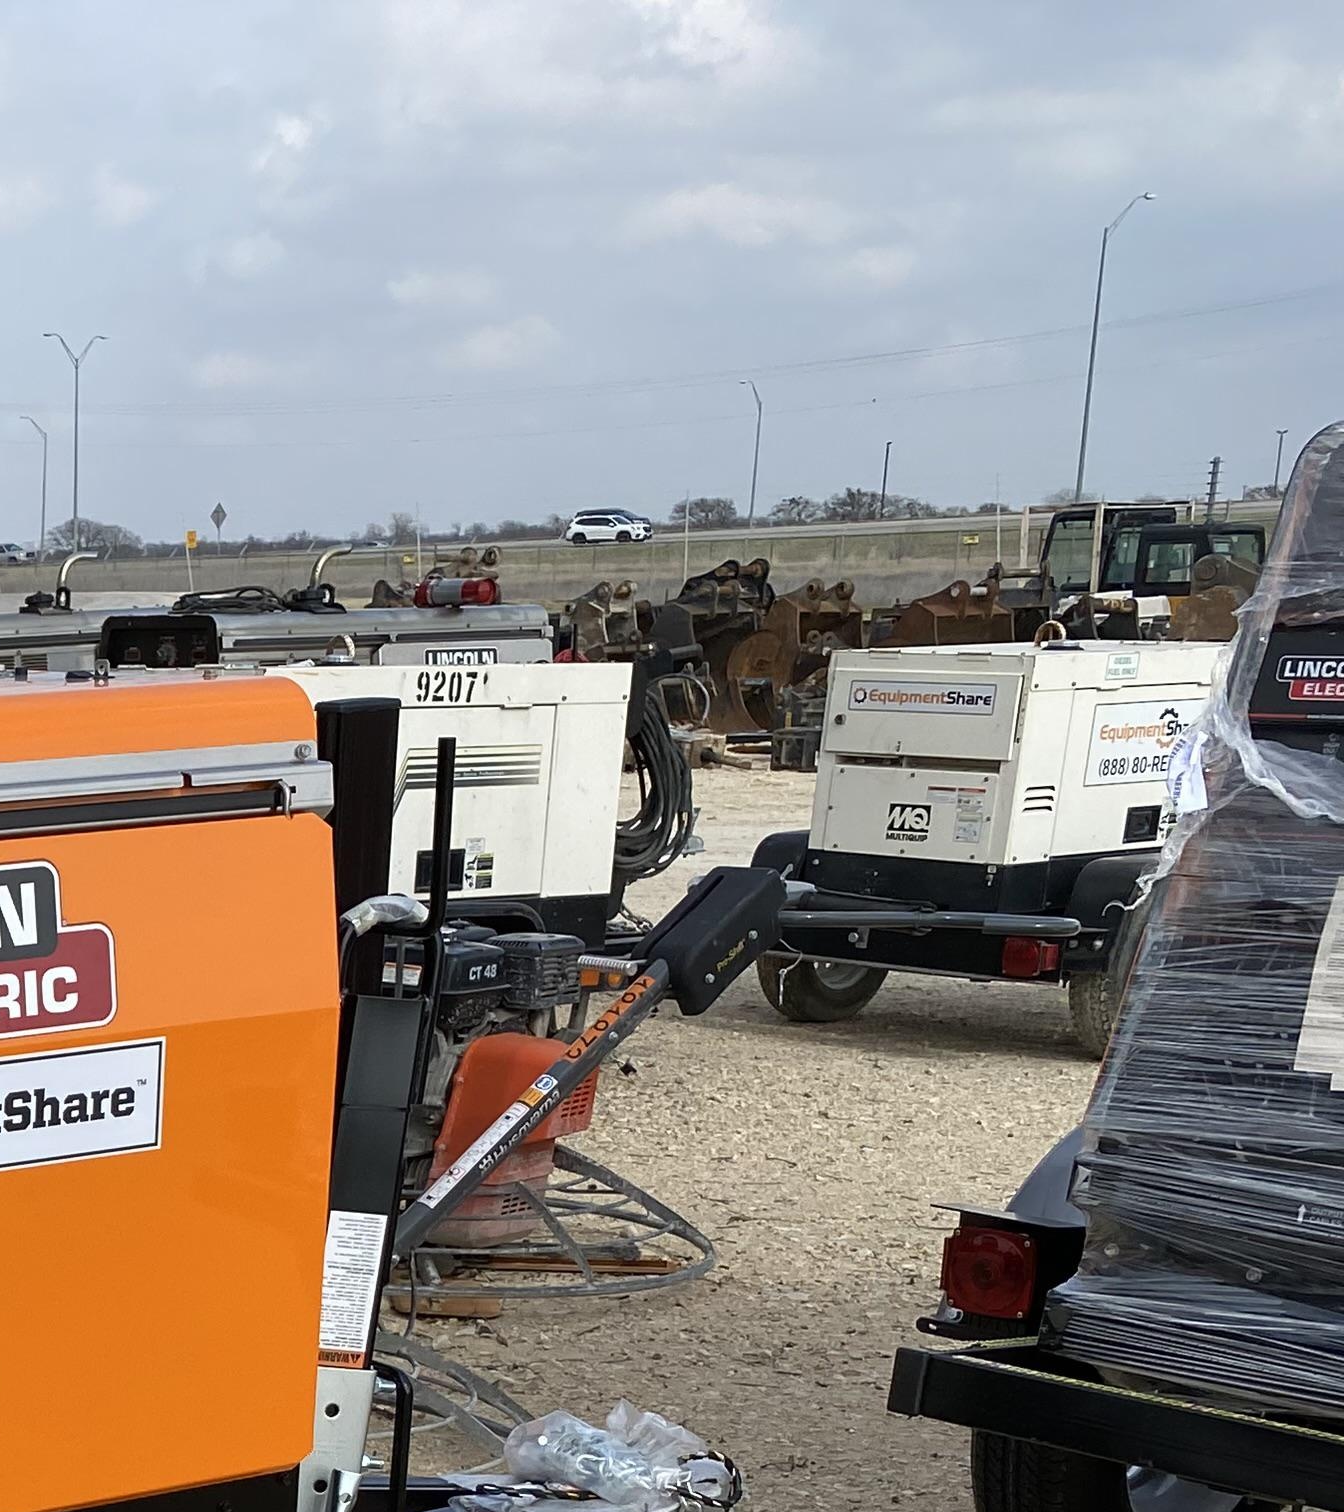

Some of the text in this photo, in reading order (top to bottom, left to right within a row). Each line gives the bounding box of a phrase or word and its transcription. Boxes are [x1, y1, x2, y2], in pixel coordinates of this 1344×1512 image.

[868, 688, 993, 706] EquipmentShare
[1098, 757, 1130, 777] (888)
[886, 805, 930, 832] MQ
[885, 831, 928, 843] MULTIQUIP
[469, 964, 498, 981] CT 48
